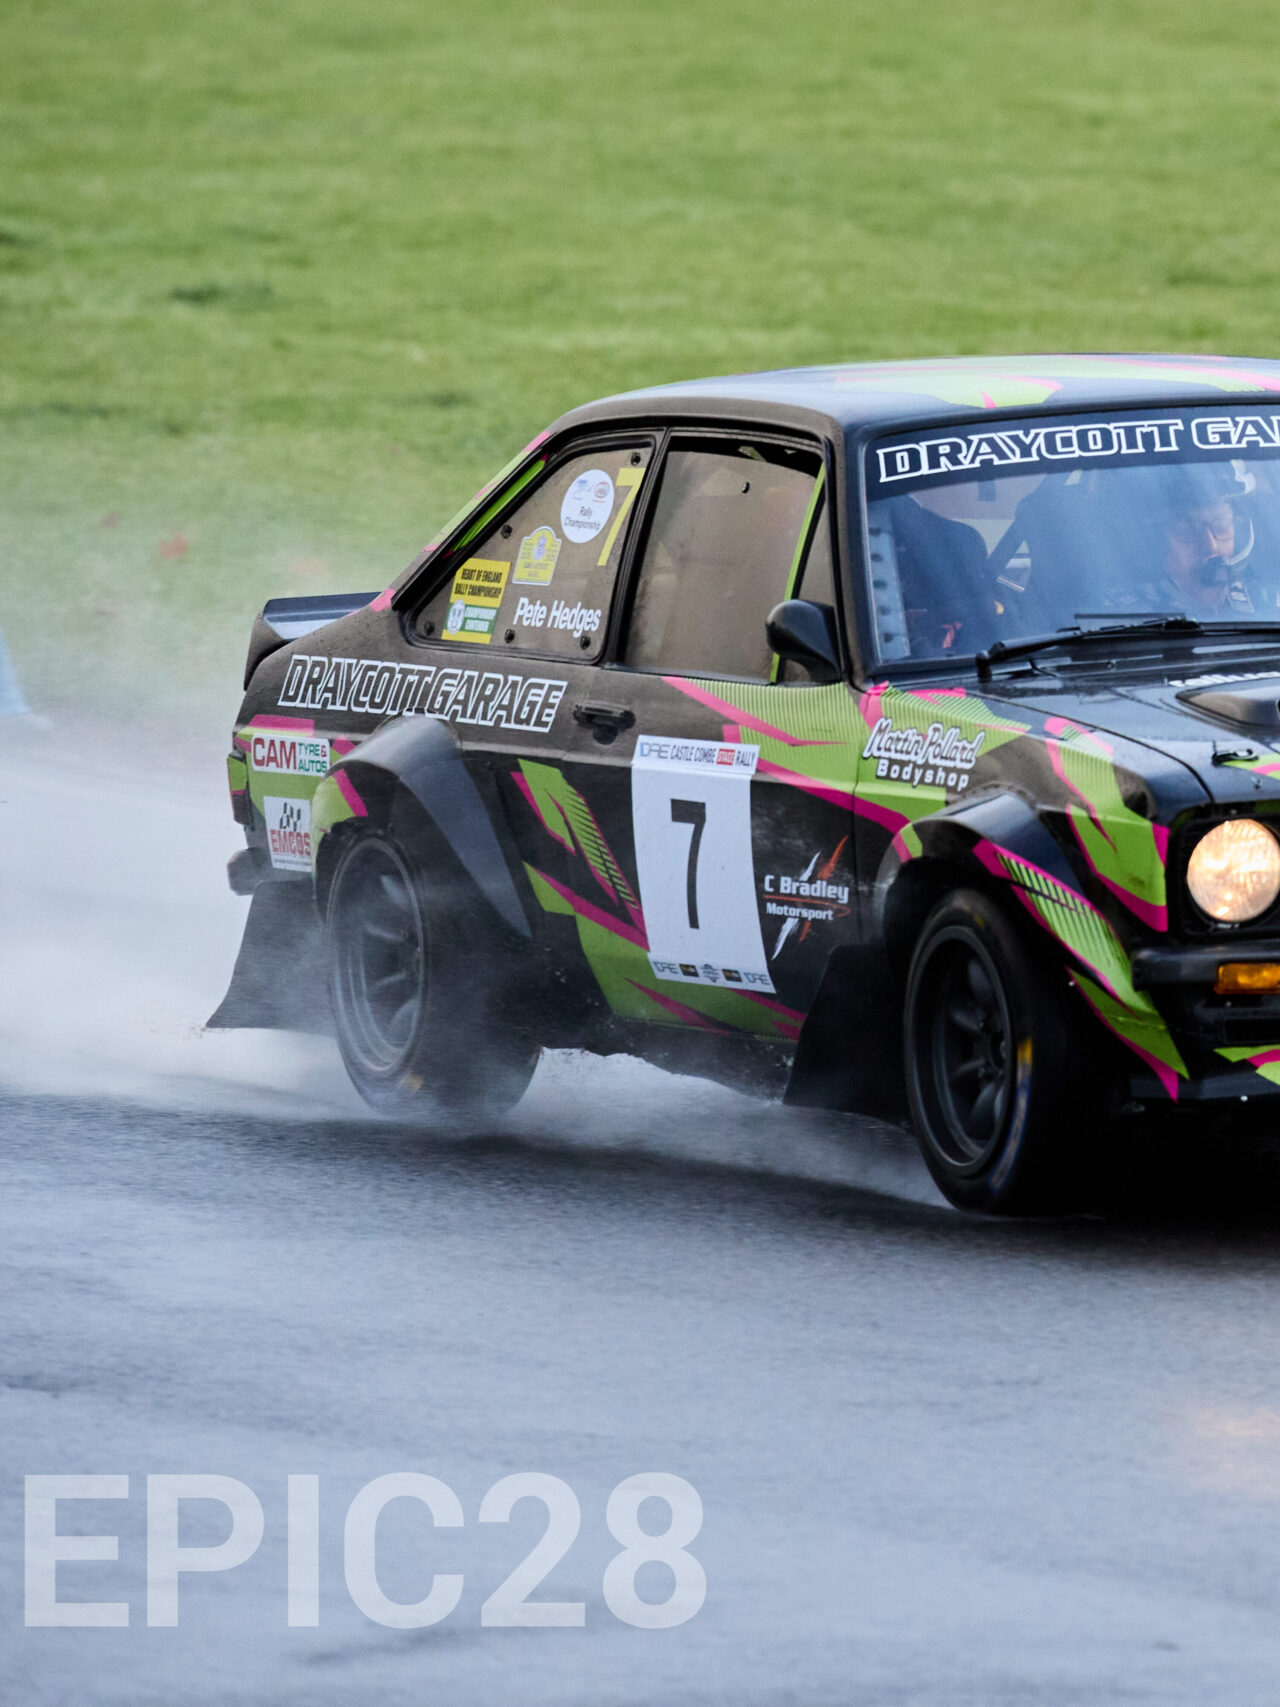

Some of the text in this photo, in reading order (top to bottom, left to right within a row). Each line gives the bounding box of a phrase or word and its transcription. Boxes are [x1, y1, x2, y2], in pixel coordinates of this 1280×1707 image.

[879, 419, 1184, 483] DRAYCOTT
[597, 467, 646, 566] 7
[513, 597, 601, 638] Pete Hedges
[277, 654, 568, 733] DRAYCOTT GARAGE
[253, 737, 297, 770] CAM
[298, 742, 328, 758] TYRE &
[670, 745, 695, 762] CASTLE
[694, 747, 718, 763] COMBE
[735, 750, 756, 766] RALLY
[861, 717, 986, 770] Martin Pollard
[298, 758, 328, 773] AUTOS
[876, 759, 970, 792] Bodyshop
[670, 798, 706, 930] 7
[764, 874, 850, 904] C Bradley
[766, 902, 834, 921] Motorsport
